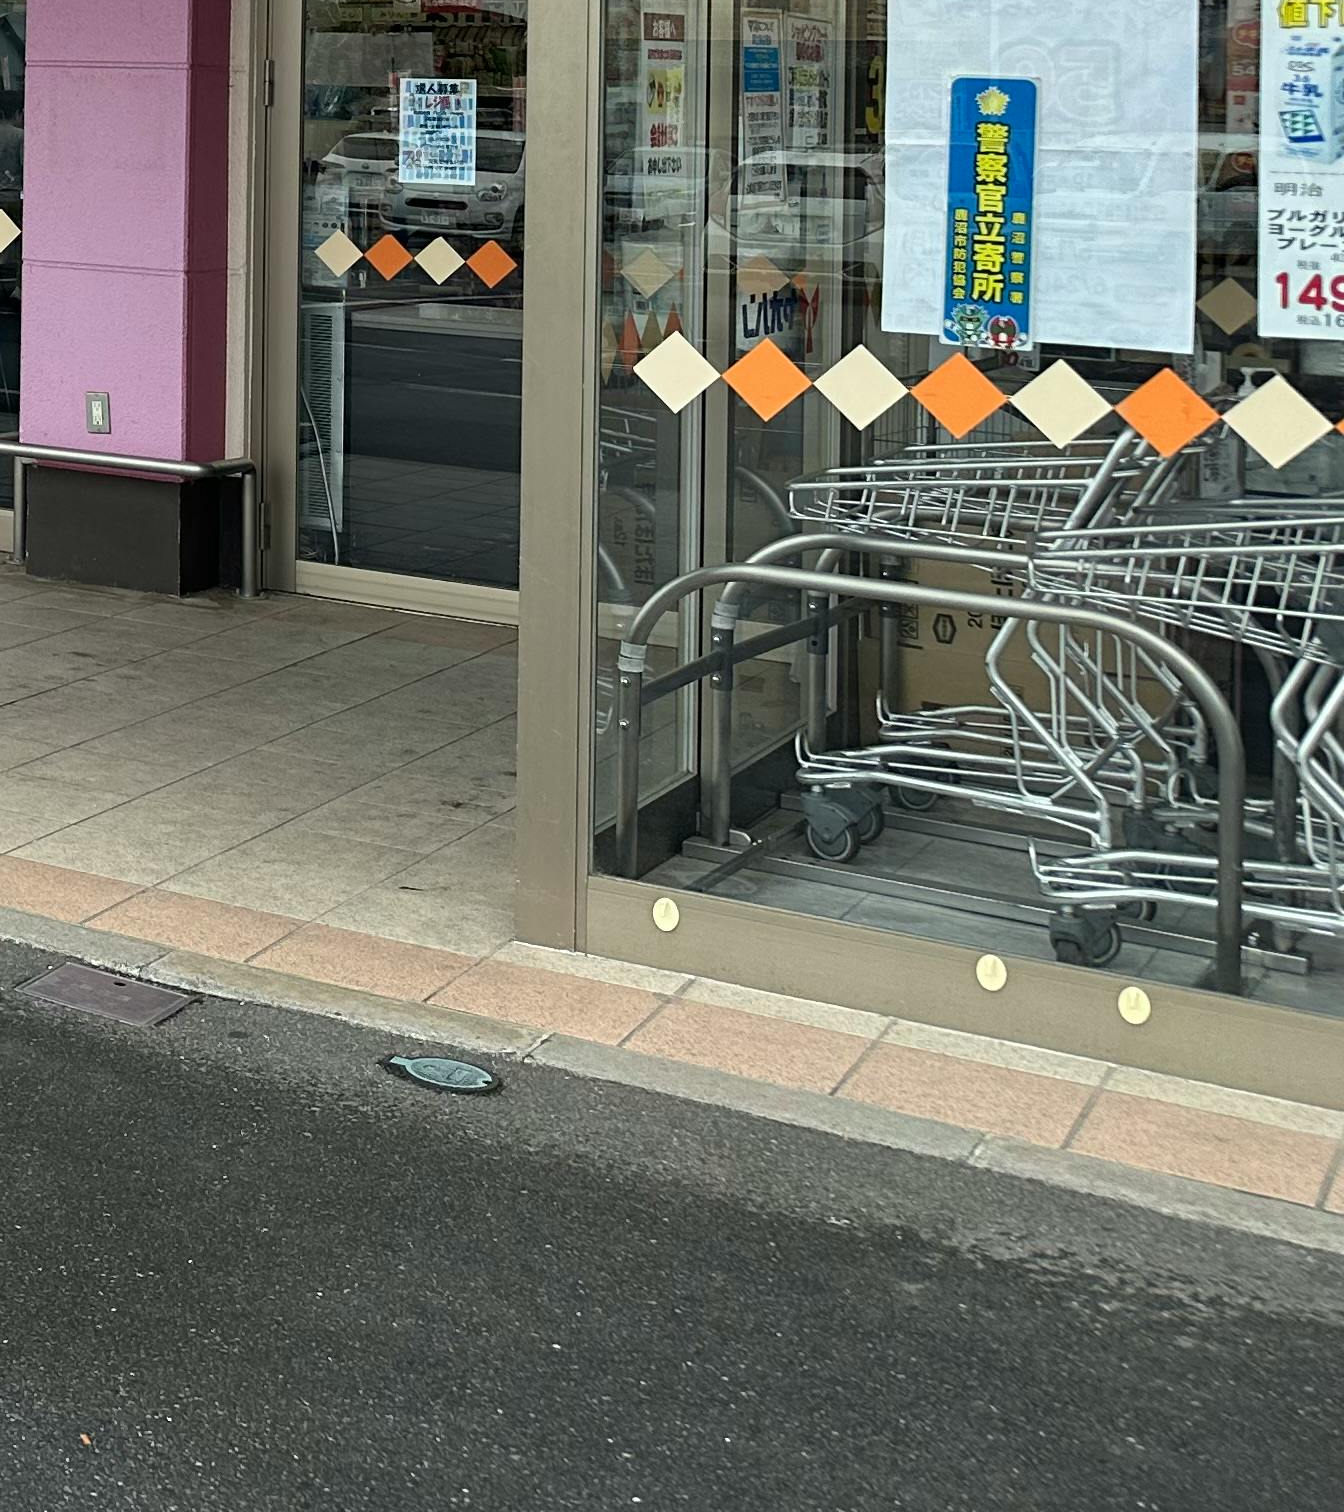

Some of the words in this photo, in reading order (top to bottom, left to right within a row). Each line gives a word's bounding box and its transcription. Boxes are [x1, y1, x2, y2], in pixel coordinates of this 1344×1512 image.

[971, 122, 1010, 303] 警察官立寄所
[1273, 182, 1324, 197] 明治
[952, 207, 969, 301] 鹿沼市防犯協会
[1009, 211, 1027, 304] 鹿沼警察署
[1276, 237, 1344, 252] プレー
